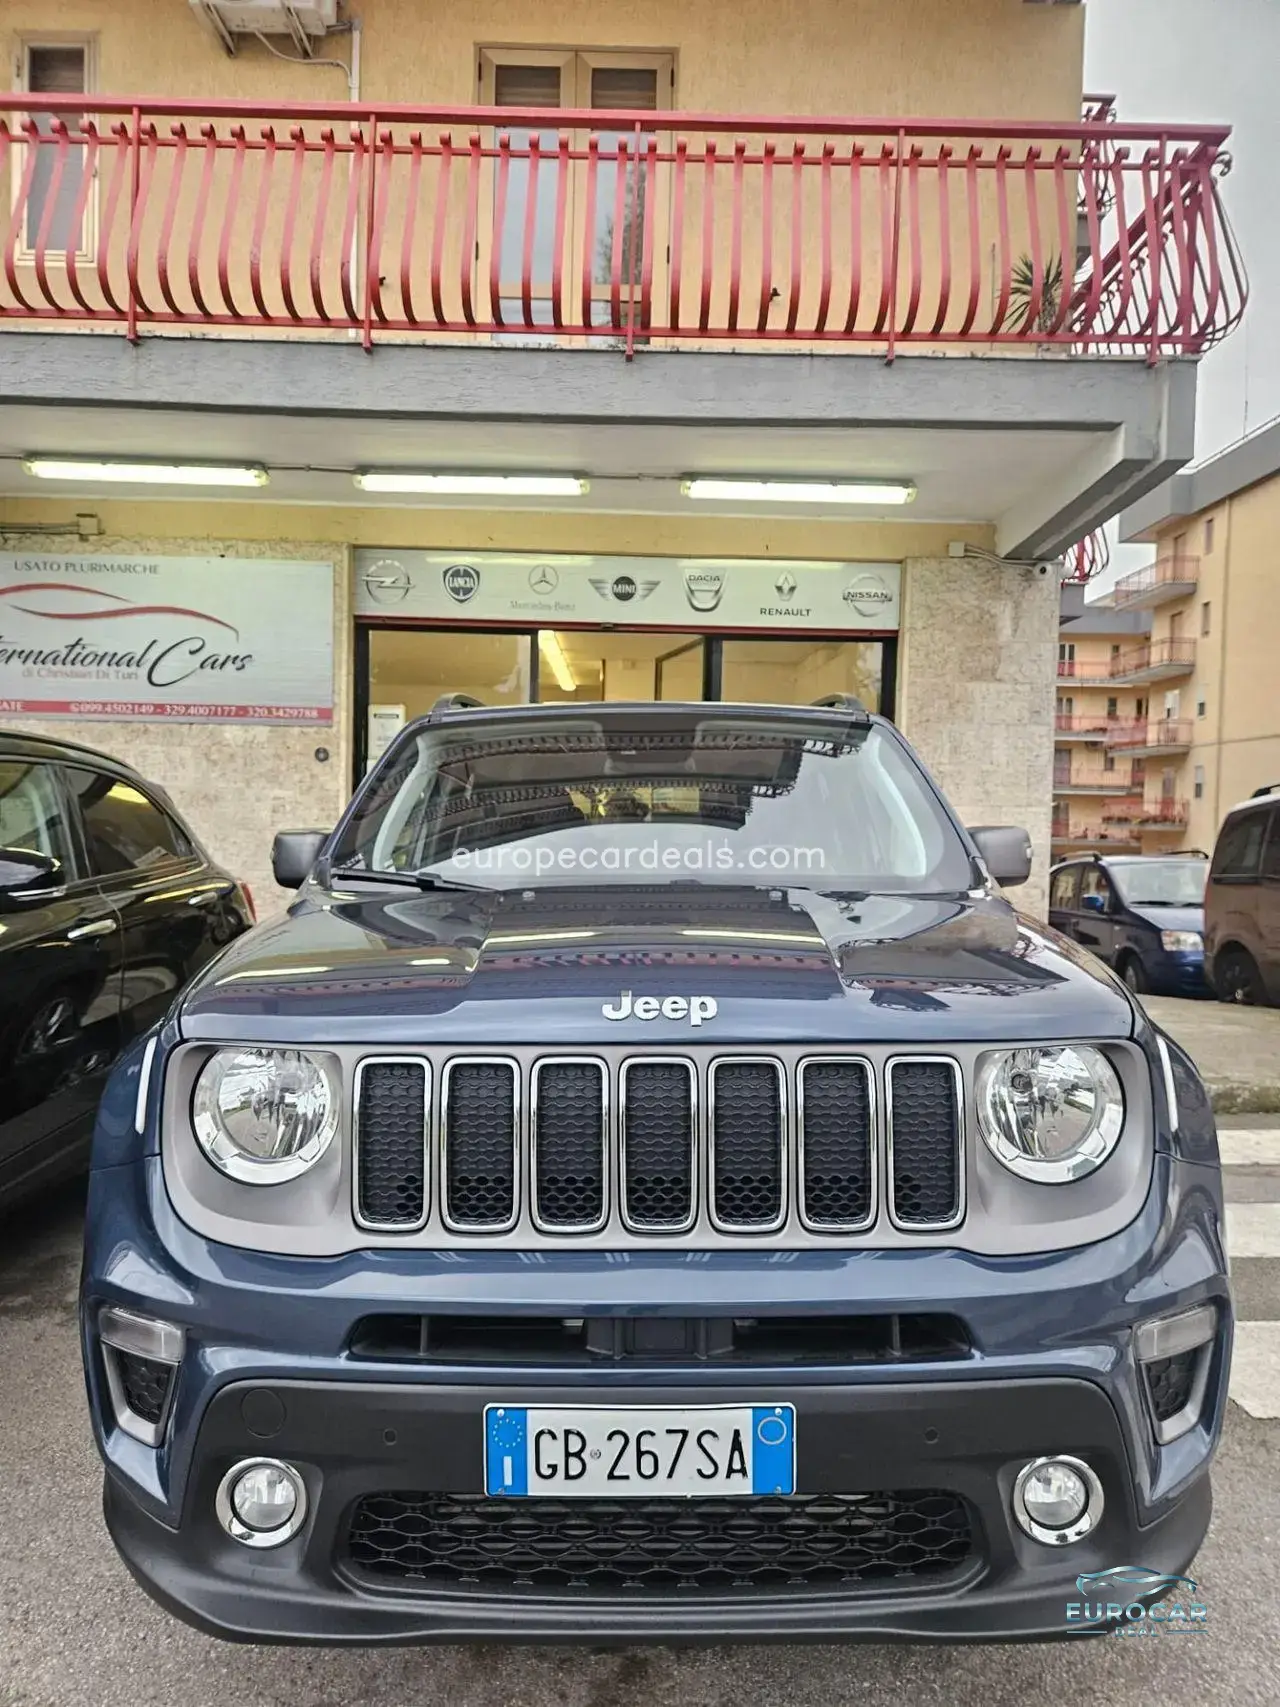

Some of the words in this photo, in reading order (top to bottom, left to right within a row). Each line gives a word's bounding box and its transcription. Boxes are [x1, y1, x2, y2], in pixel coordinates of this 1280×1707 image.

[14, 560, 61, 573] USATO
[64, 562, 160, 575] PLURIMARCHE
[688, 574, 721, 583] DACIA
[613, 584, 636, 594] MINI
[847, 591, 888, 600] NISSAN
[759, 607, 812, 617] RENAULT
[147, 636, 253, 687] Cars
[602, 990, 718, 1028] Jeep
